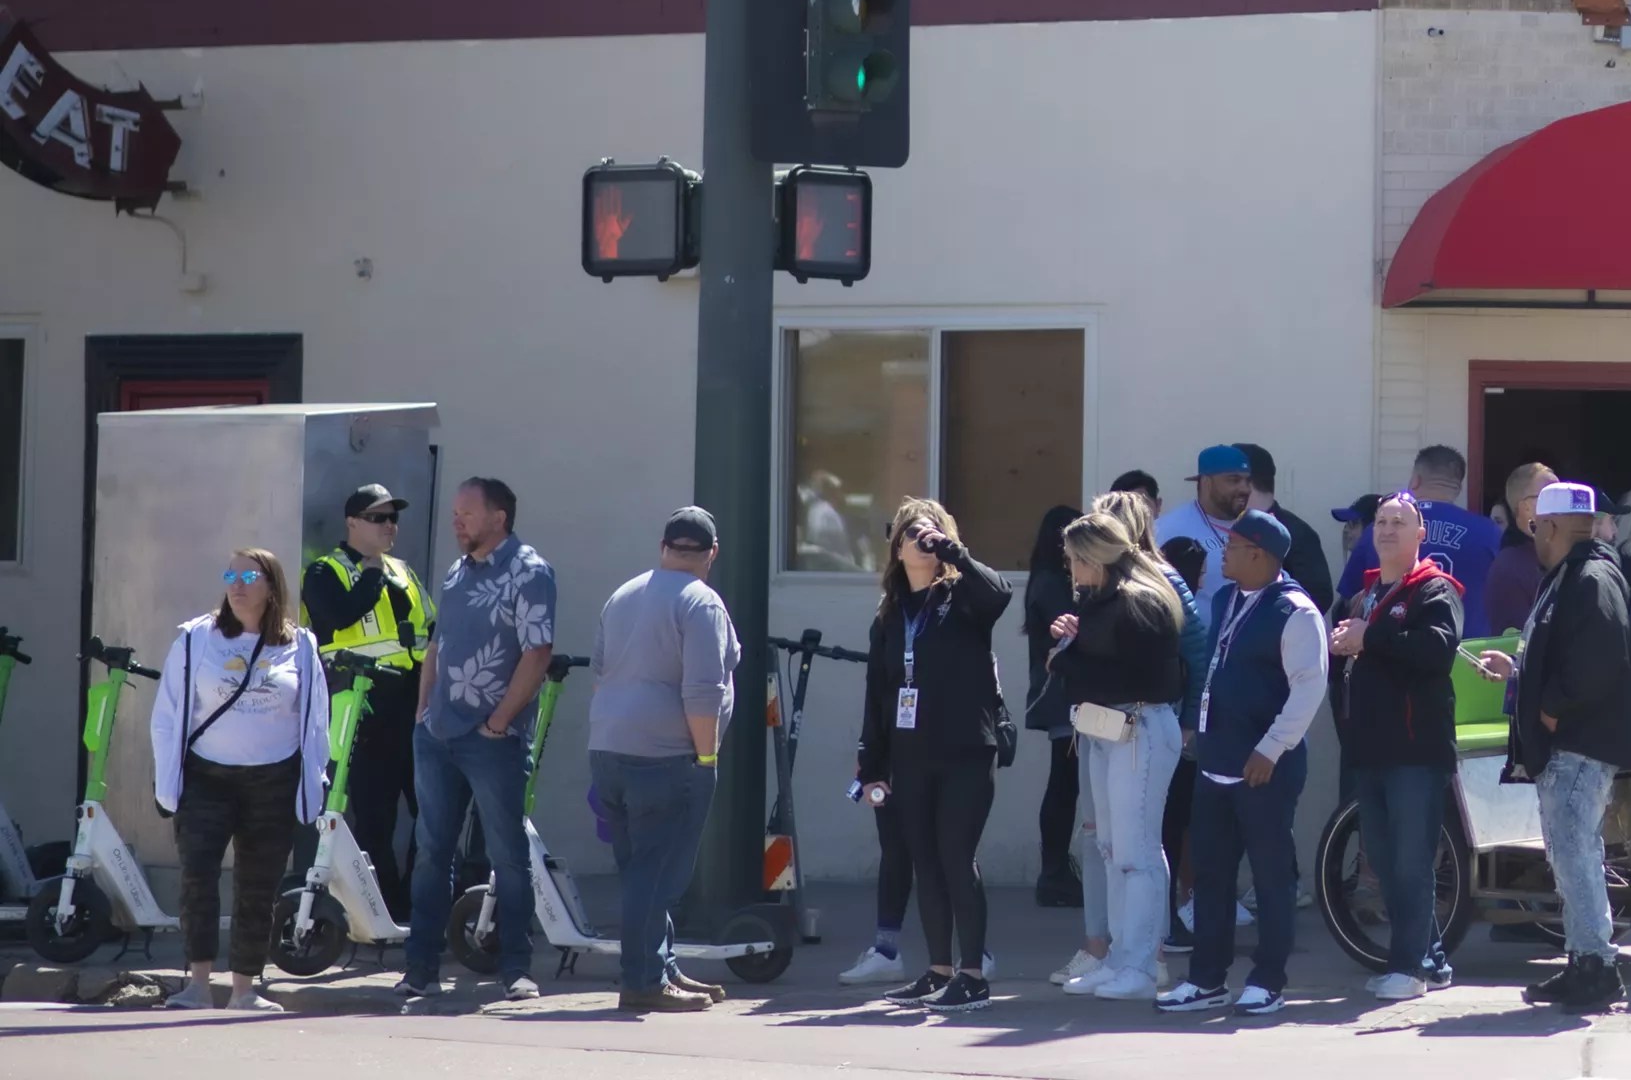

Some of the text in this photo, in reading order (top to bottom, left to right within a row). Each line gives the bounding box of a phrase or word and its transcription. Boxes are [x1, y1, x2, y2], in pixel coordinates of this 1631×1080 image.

[0, 40, 141, 173] EAT
[110, 847, 123, 862] On
[351, 859, 362, 873] On
